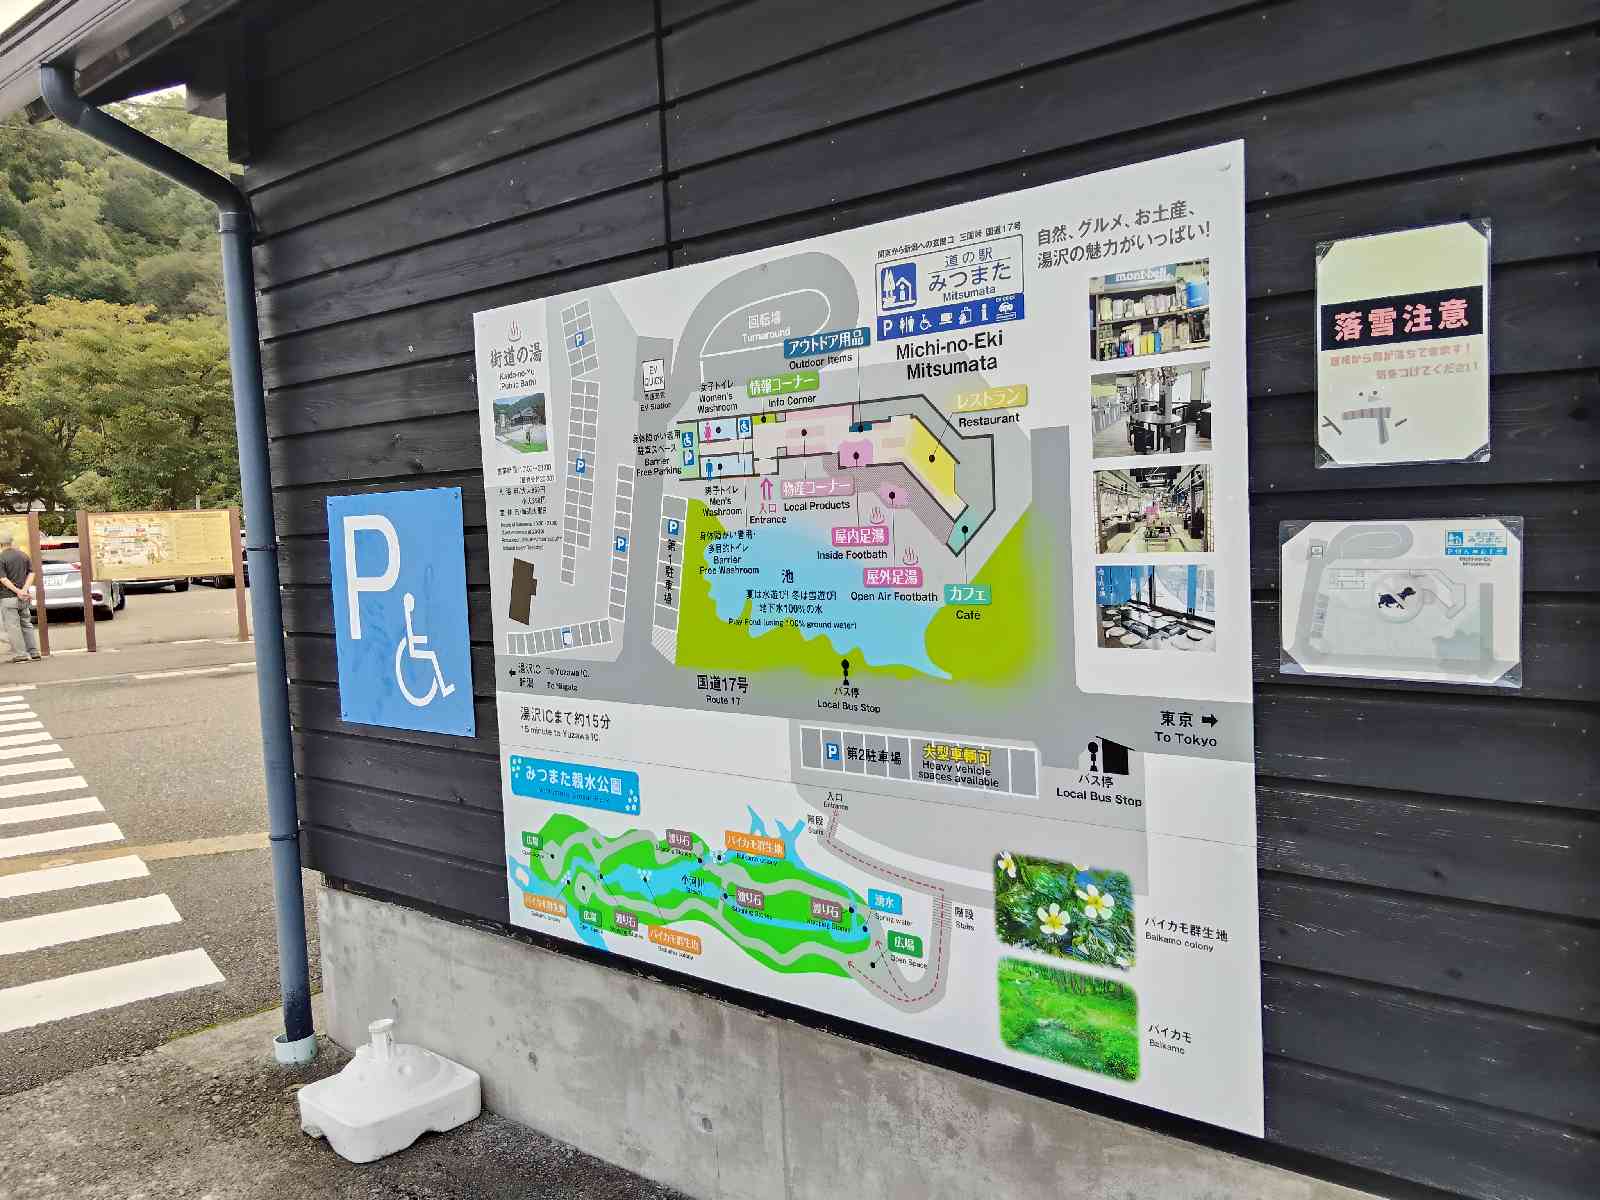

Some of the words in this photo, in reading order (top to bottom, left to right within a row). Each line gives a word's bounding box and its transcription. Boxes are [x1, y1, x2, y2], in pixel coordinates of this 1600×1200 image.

[1037, 199, 1195, 246] 自然、グルメ、お土産、
[945, 246, 993, 268] 道の駅
[928, 261, 1012, 292] みつまた
[943, 285, 996, 303] Mitsumata
[1333, 298, 1469, 342] 落雪注意
[742, 328, 791, 343] Turnaround
[788, 329, 865, 355] アウトドア用品
[895, 329, 1004, 361] Michi-no-Eki
[490, 342, 543, 368] 街道の湯
[789, 357, 825, 370] Outdoor
[827, 353, 853, 365] Items
[907, 355, 998, 381] Mitsumata
[701, 380, 734, 392] 女子トイレ
[749, 374, 817, 395] 情報コーナー
[700, 392, 733, 403] Women's
[768, 397, 786, 407] Info
[787, 394, 817, 406] Corner
[958, 387, 1019, 409] レストラン
[959, 412, 1020, 428] Restaurant
[783, 479, 851, 496] 物産コーナー
[759, 504, 777, 514] 入口
[784, 501, 808, 512] Local
[809, 501, 851, 511] Products
[749, 516, 787, 524] Entrance
[835, 528, 885, 544] 屋内足湯
[713, 555, 742, 564] Barrier
[817, 550, 844, 560] Inside
[845, 550, 888, 559] Footbath
[344, 514, 401, 640] P
[781, 569, 794, 584] 池
[866, 569, 918, 585] 屋外足湯
[850, 592, 875, 602] Open
[878, 592, 891, 601] Air
[894, 592, 938, 602] Footbath
[949, 586, 986, 601] カフェ
[697, 674, 749, 694] 国道17号
[834, 687, 860, 698] バス停
[706, 694, 729, 705] Route
[731, 696, 741, 706] 17
[817, 700, 840, 710] Local
[842, 702, 858, 712] Bus
[860, 703, 881, 714] Stop
[520, 705, 612, 730] 湯沢ICまで約15分
[1159, 710, 1194, 728] 東京
[1154, 731, 1171, 743] To
[1175, 733, 1218, 748] Tokyo
[847, 746, 902, 765] 第2駐車場
[922, 760, 953, 773] Heavy
[955, 764, 992, 776] vehicle
[525, 765, 622, 796] みつまた親水公園
[918, 771, 953, 783] spaces
[954, 773, 1000, 788] available
[1078, 775, 1114, 789] バス停
[827, 791, 843, 802] 入口
[1056, 787, 1087, 800] Local
[1090, 791, 1112, 803] Bus
[1115, 795, 1143, 808] Stop
[1144, 917, 1229, 943] バイカモ群生地
[1145, 931, 1182, 946] Baikamo
[1184, 940, 1214, 953] colony
[1148, 1024, 1193, 1044] バイカモ
